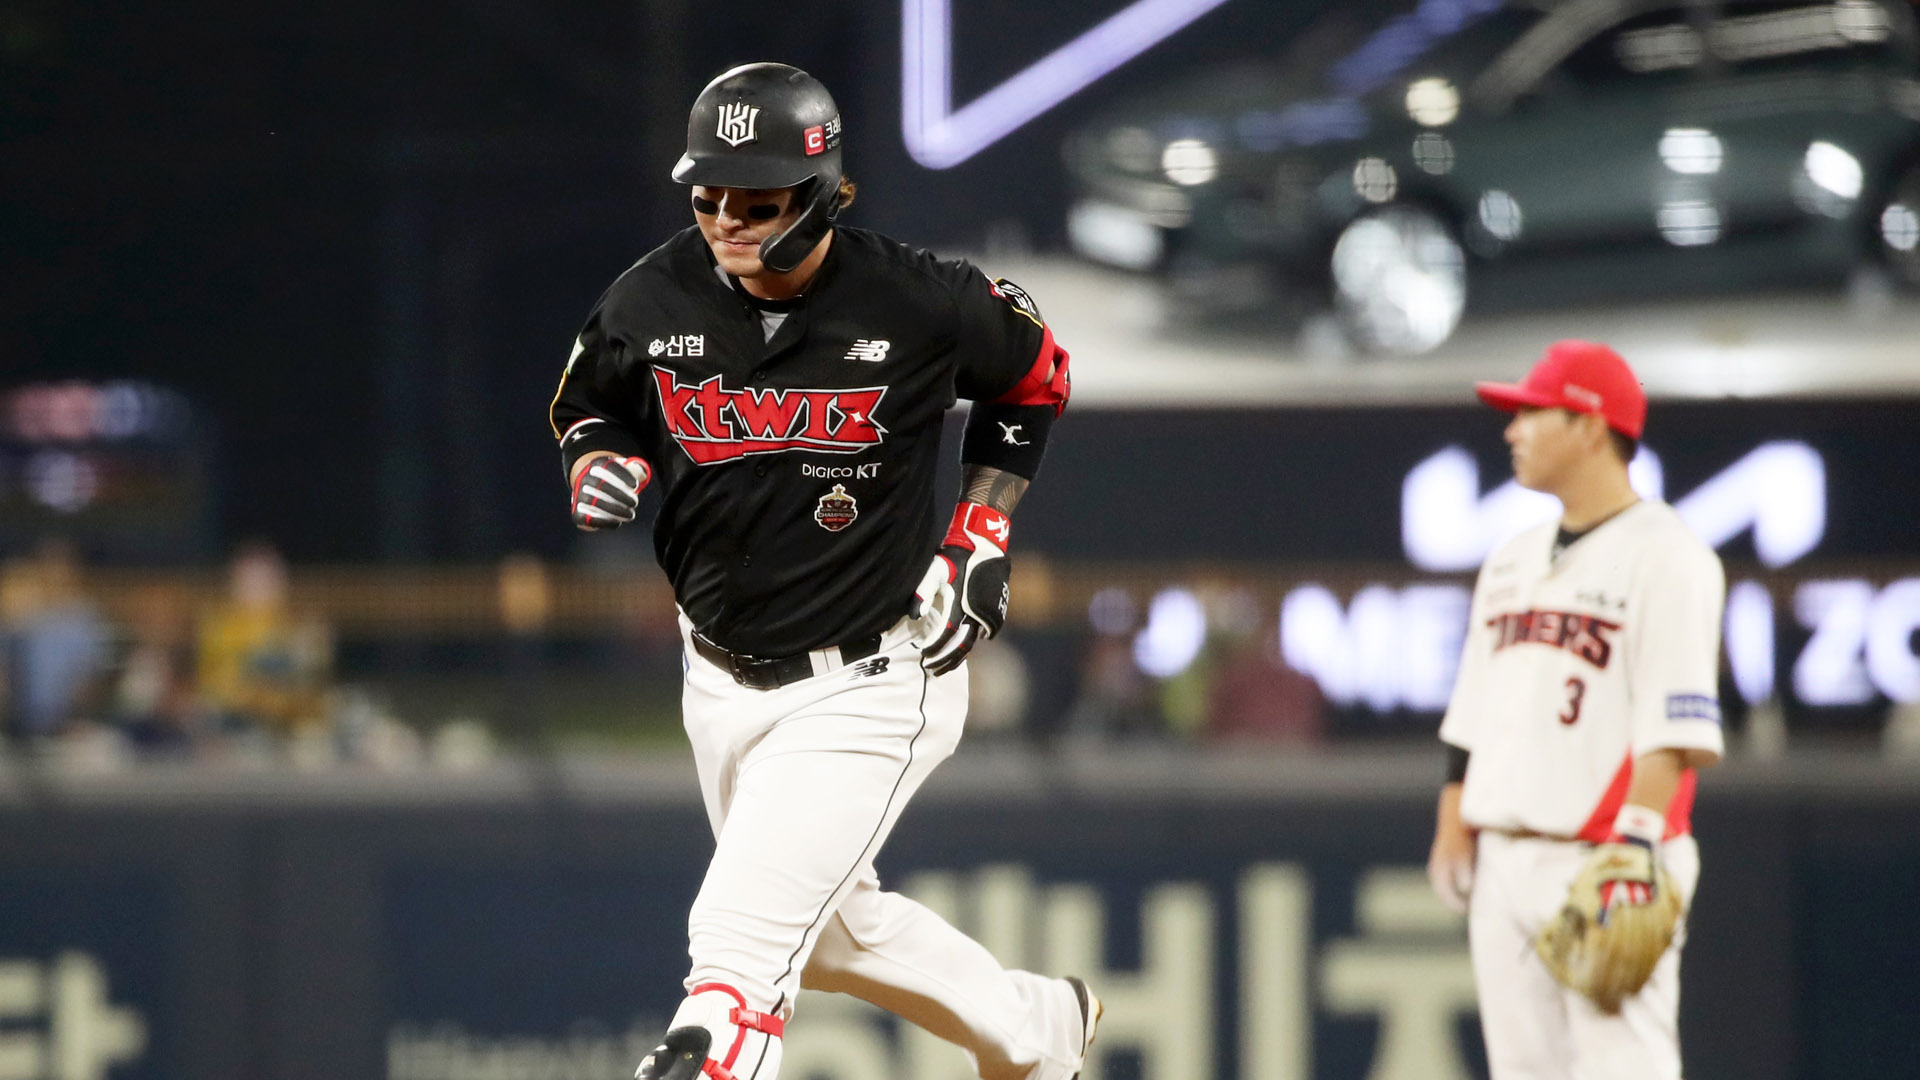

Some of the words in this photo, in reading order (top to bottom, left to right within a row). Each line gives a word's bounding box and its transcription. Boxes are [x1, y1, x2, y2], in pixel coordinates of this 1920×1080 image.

[665, 334, 704, 357] 신협
[802, 463, 853, 479] DIGICO
[856, 462, 882, 479] KT
[1559, 676, 1586, 726] 3
